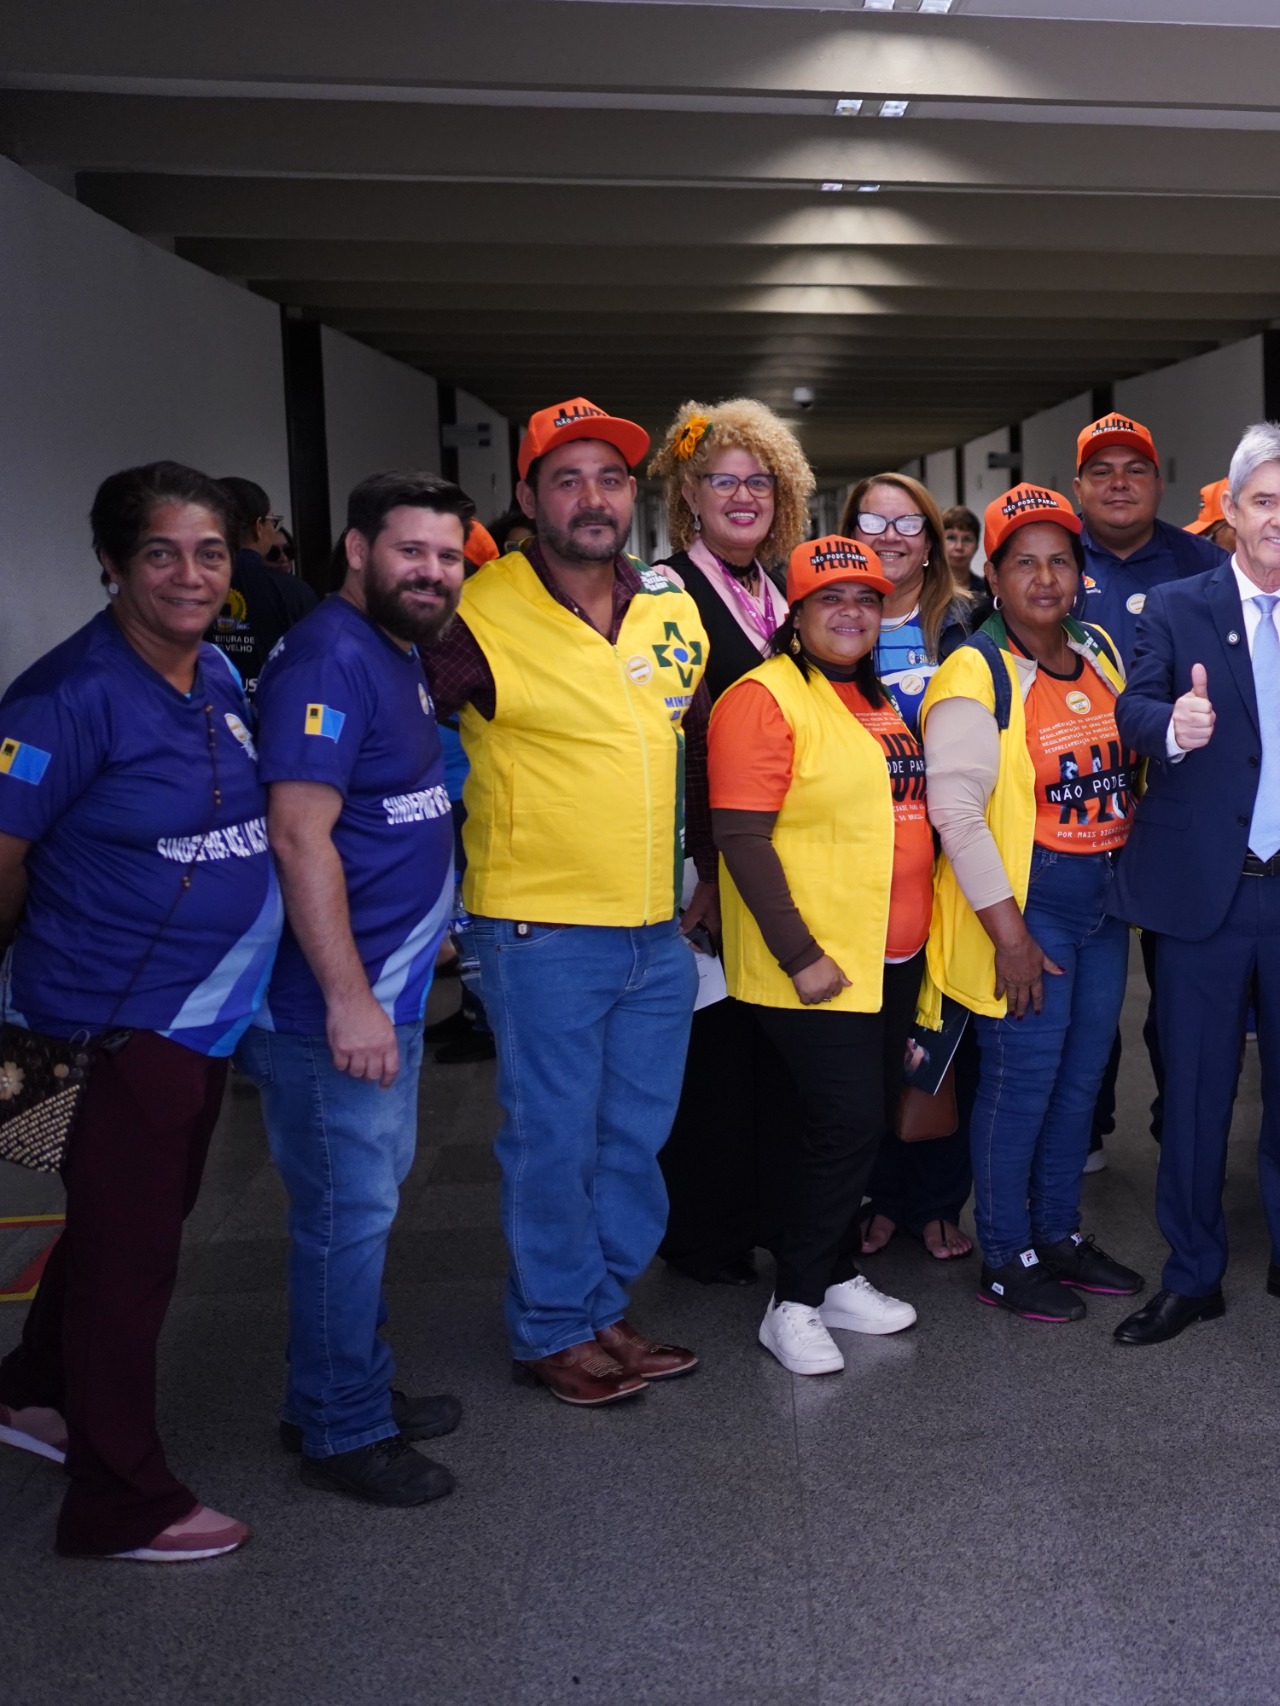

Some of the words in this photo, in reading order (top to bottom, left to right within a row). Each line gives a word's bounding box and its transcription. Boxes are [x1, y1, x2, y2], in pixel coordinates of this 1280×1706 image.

[1003, 504, 1016, 513] NÃO
[811, 556, 825, 564] NÃO
[846, 553, 867, 561] PARAR
[1050, 783, 1083, 802] NÃO
[1092, 773, 1127, 793] PODE
[1057, 830, 1073, 839] POR
[1077, 830, 1097, 839] MAIS
[1092, 840, 1097, 849] E
